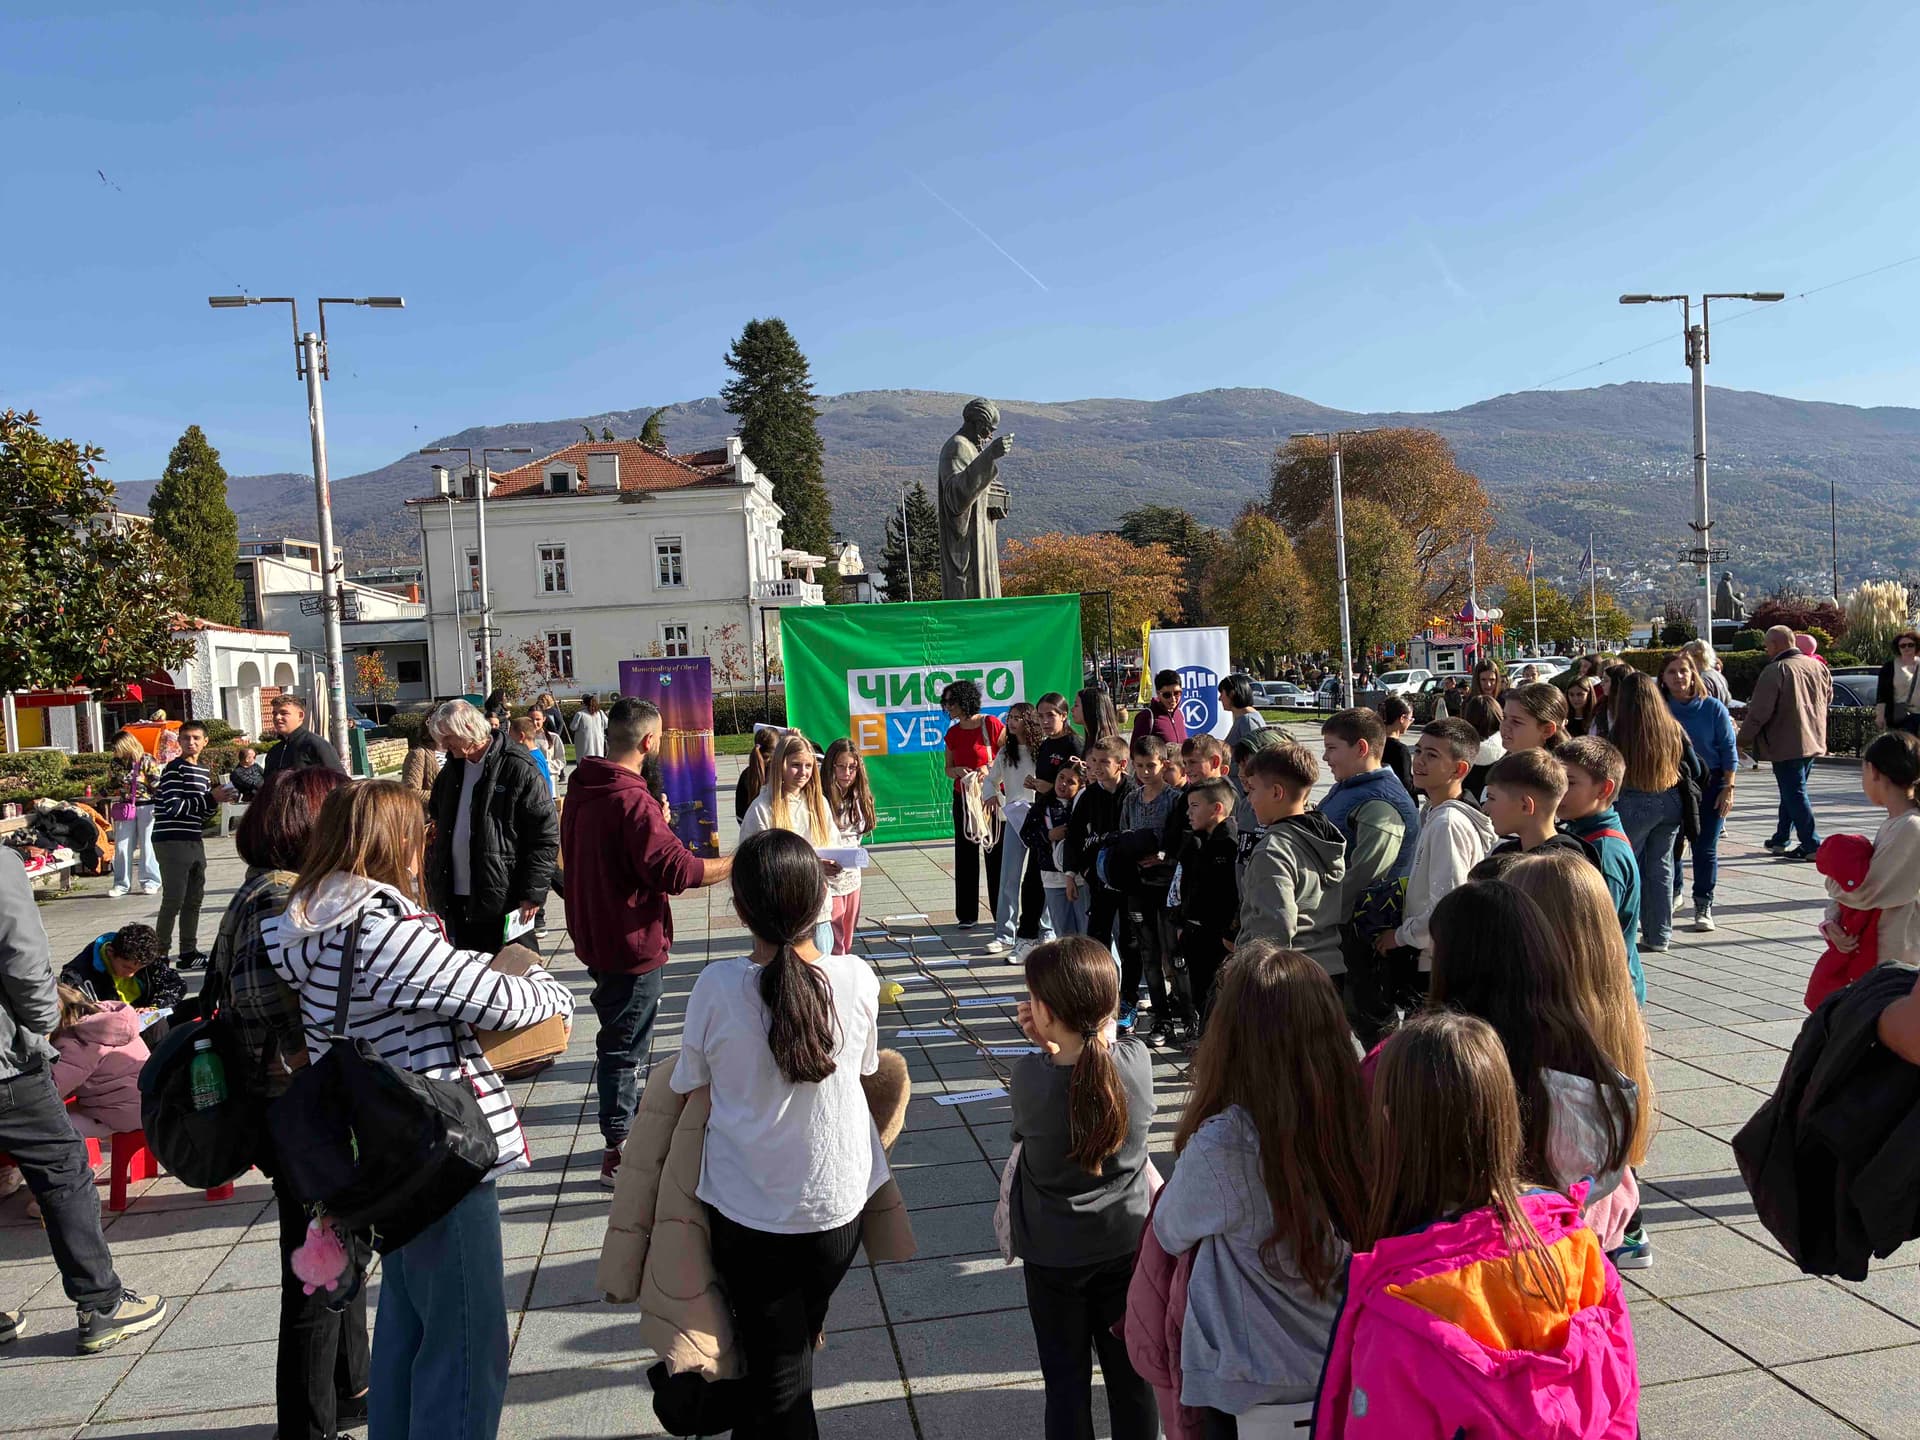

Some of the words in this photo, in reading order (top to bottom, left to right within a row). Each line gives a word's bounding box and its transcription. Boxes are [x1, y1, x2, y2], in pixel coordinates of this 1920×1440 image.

[632, 665, 671, 673] Municipality
[857, 667, 1015, 708] ЧИСТО
[859, 719, 880, 750] Е
